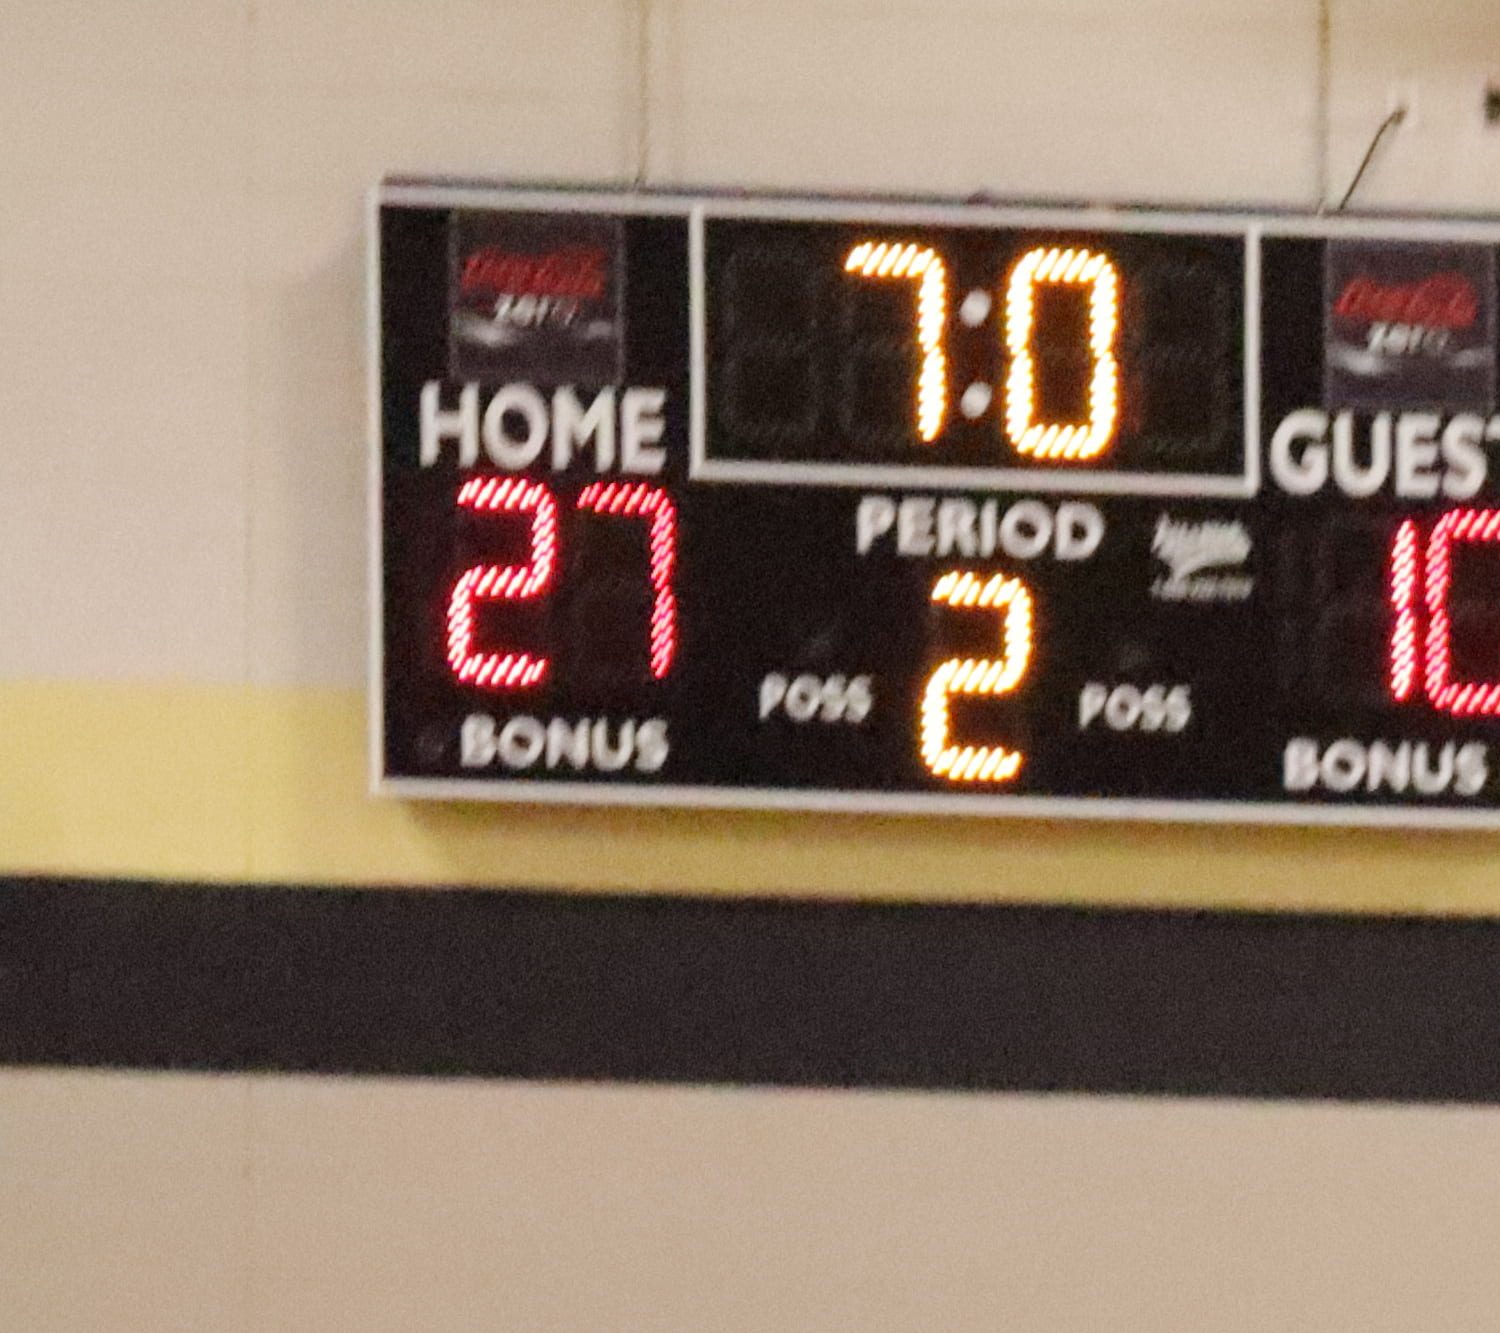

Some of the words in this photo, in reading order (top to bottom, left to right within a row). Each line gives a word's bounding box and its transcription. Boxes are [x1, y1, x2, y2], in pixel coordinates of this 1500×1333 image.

[418, 380, 668, 473] HOME
[855, 494, 1105, 562] PERIOD
[446, 475, 678, 688] 27
[758, 673, 873, 724] POSS
[918, 570, 1037, 784] 2
[1078, 682, 1193, 733] POSS
[459, 713, 670, 773] BONUS
[1282, 736, 1489, 797] BONUS
